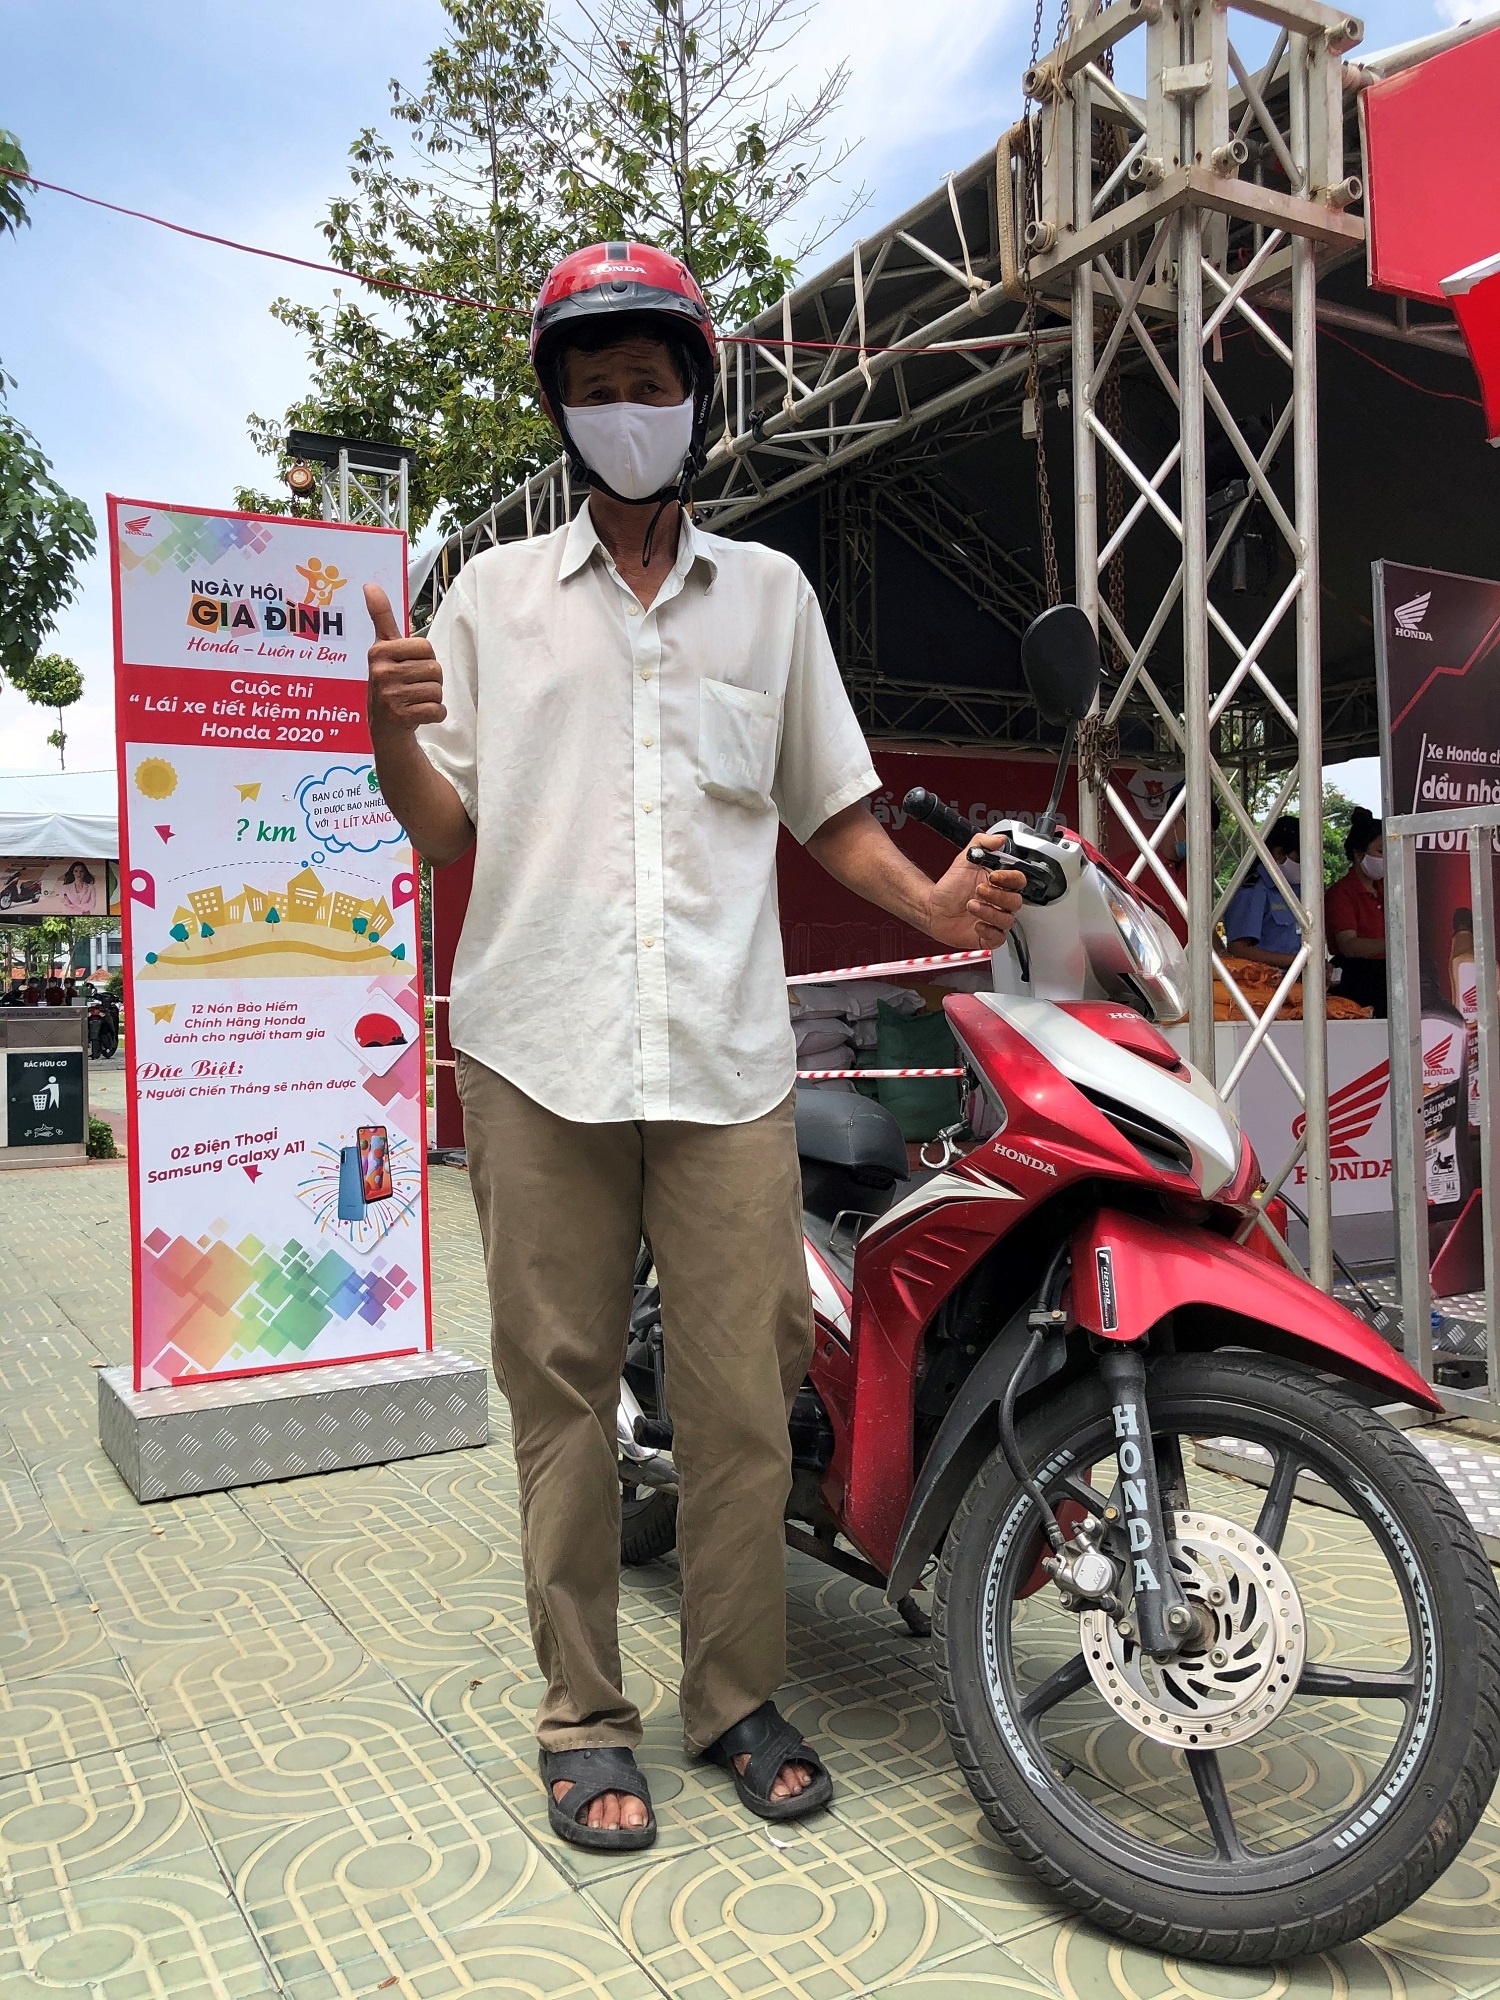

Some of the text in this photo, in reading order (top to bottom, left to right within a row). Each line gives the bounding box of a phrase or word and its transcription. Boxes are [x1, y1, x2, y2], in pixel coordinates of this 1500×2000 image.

[589, 265, 647, 275] HONDA
[698, 394, 709, 424] HONDA
[191, 579, 283, 604] NGÀY HỘI
[192, 600, 343, 636] GIA ĐÌNH
[1395, 627, 1433, 641] HONDA
[186, 636, 240, 654] Honda
[257, 642, 295, 658] Luôn
[300, 646, 313, 660] vì
[316, 646, 348, 664] Bạn
[230, 679, 314, 699] Cuộc thi
[144, 696, 178, 713] Lái
[182, 702, 207, 714] xe
[212, 699, 246, 717] tiết
[251, 702, 300, 722] kiệm
[306, 706, 360, 723] nhiên
[201, 722, 271, 740] Honda
[275, 727, 324, 743] 2020
[1427, 743, 1444, 759] Xe
[1446, 745, 1487, 763] Honda
[312, 784, 362, 803] BẠN CÓ THỂ
[1422, 772, 1461, 801] dầu
[314, 807, 322, 816] ĐI
[324, 803, 346, 815] ĐƯỢC
[347, 801, 363, 811] BAO
[236, 818, 297, 842] ? km
[315, 818, 329, 829] VỚI
[334, 819, 340, 829] 1
[343, 814, 360, 829] LÍT
[191, 1001, 298, 1014] 12 Nón Bảo Hiểm
[184, 1015, 306, 1029] Chính Hãng Honda
[163, 1028, 326, 1044] dành cho người tham gia
[23, 1060, 39, 1068] RÁC
[40, 1059, 55, 1067] HỮU
[136, 1059, 244, 1082] Đặc Biệt:
[1424, 1067, 1455, 1077] HONDA
[146, 1086, 185, 1101] Người
[189, 1084, 226, 1097] Chiến
[230, 1081, 270, 1095] Thắng
[274, 1080, 287, 1092] sẽ
[291, 1080, 323, 1093] nhận
[326, 1078, 357, 1090] được
[171, 1126, 278, 1160] 02 Điện Thoại
[147, 1140, 305, 1184] Samsung Galaxy A11
[992, 1142, 1058, 1176] HONDA
[1112, 1404, 1160, 1592] HONDA
[986, 1554, 1004, 1691] HONDA
[1413, 1572, 1433, 1727] HONDA
